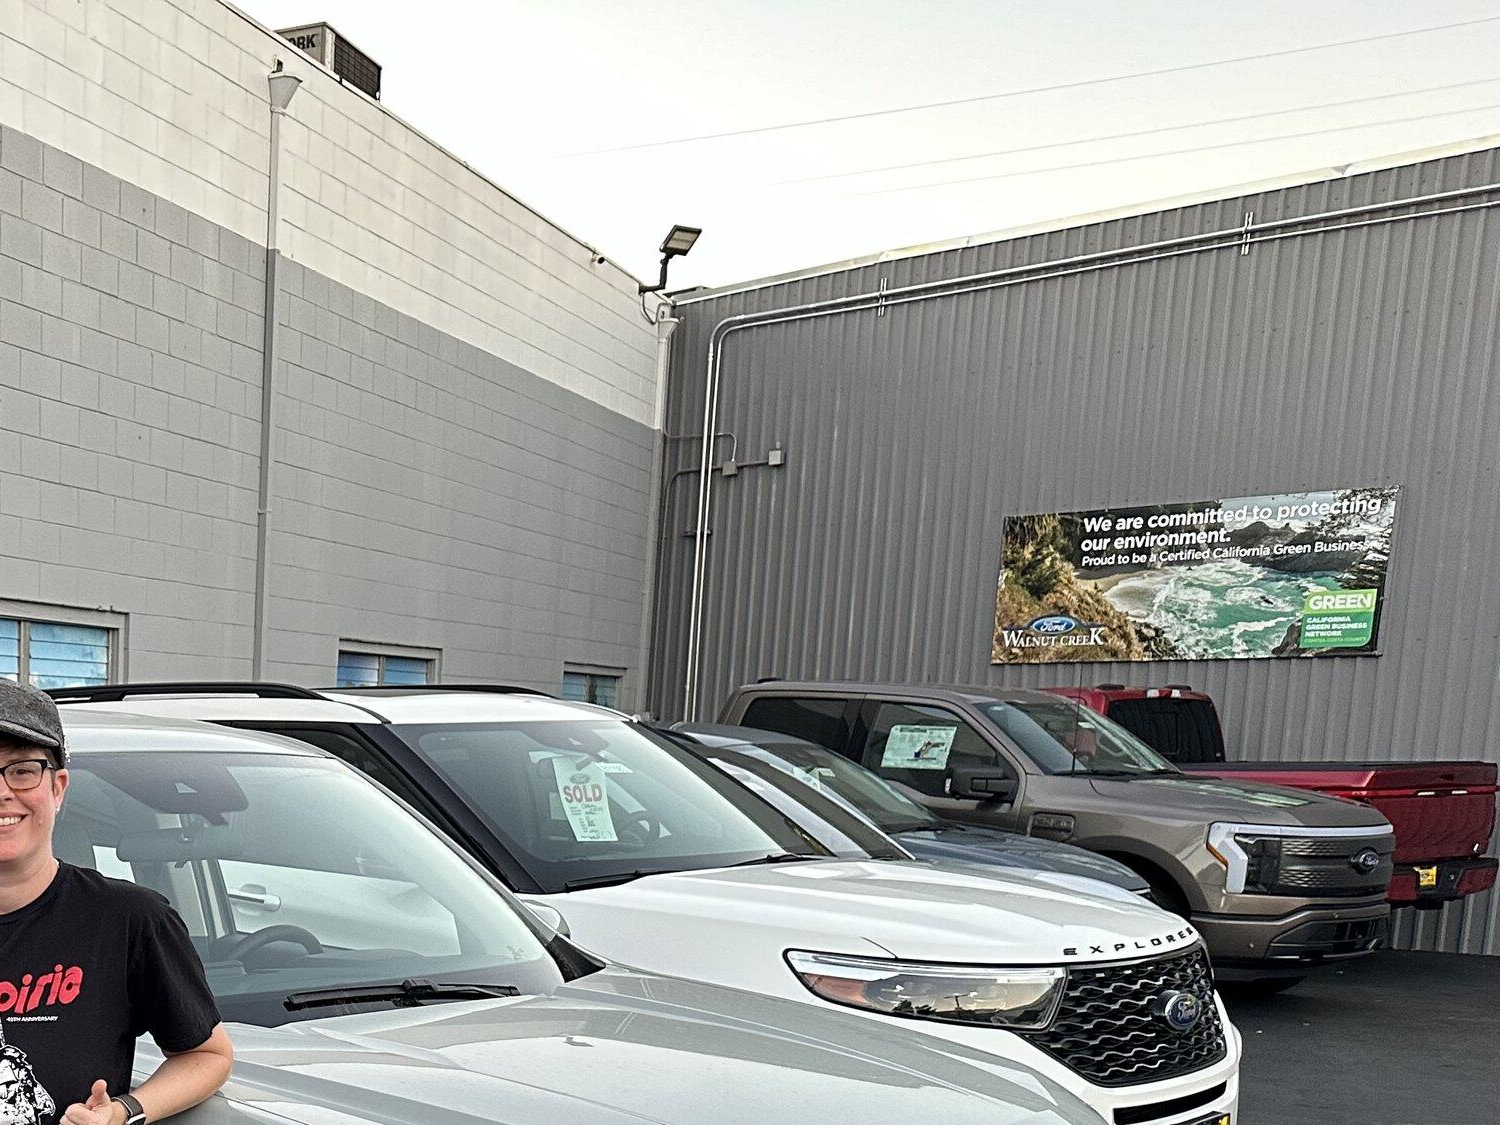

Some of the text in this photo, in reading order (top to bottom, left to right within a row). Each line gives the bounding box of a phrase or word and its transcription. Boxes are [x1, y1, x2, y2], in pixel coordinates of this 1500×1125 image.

[1083, 498, 1382, 533] We are committed to protecting
[1081, 527, 1232, 552] our environment.
[1082, 553, 1116, 567] Proud
[1117, 554, 1131, 566] to
[1132, 551, 1148, 564] be
[1149, 553, 1157, 563] a
[1158, 547, 1210, 562] Certified
[1213, 544, 1271, 560] California
[1273, 541, 1312, 556] Green
[1309, 593, 1373, 610] GREEN
[1040, 618, 1067, 632] Ford
[1305, 622, 1368, 631] GREEN BUSINESS
[1306, 616, 1352, 624] CALIFORNIA
[1002, 627, 1106, 648] WALNUT CREEK
[1305, 630, 1342, 638] NETWORK
[563, 783, 603, 803] SOLD
[1063, 926, 1194, 956] EXPLORER
